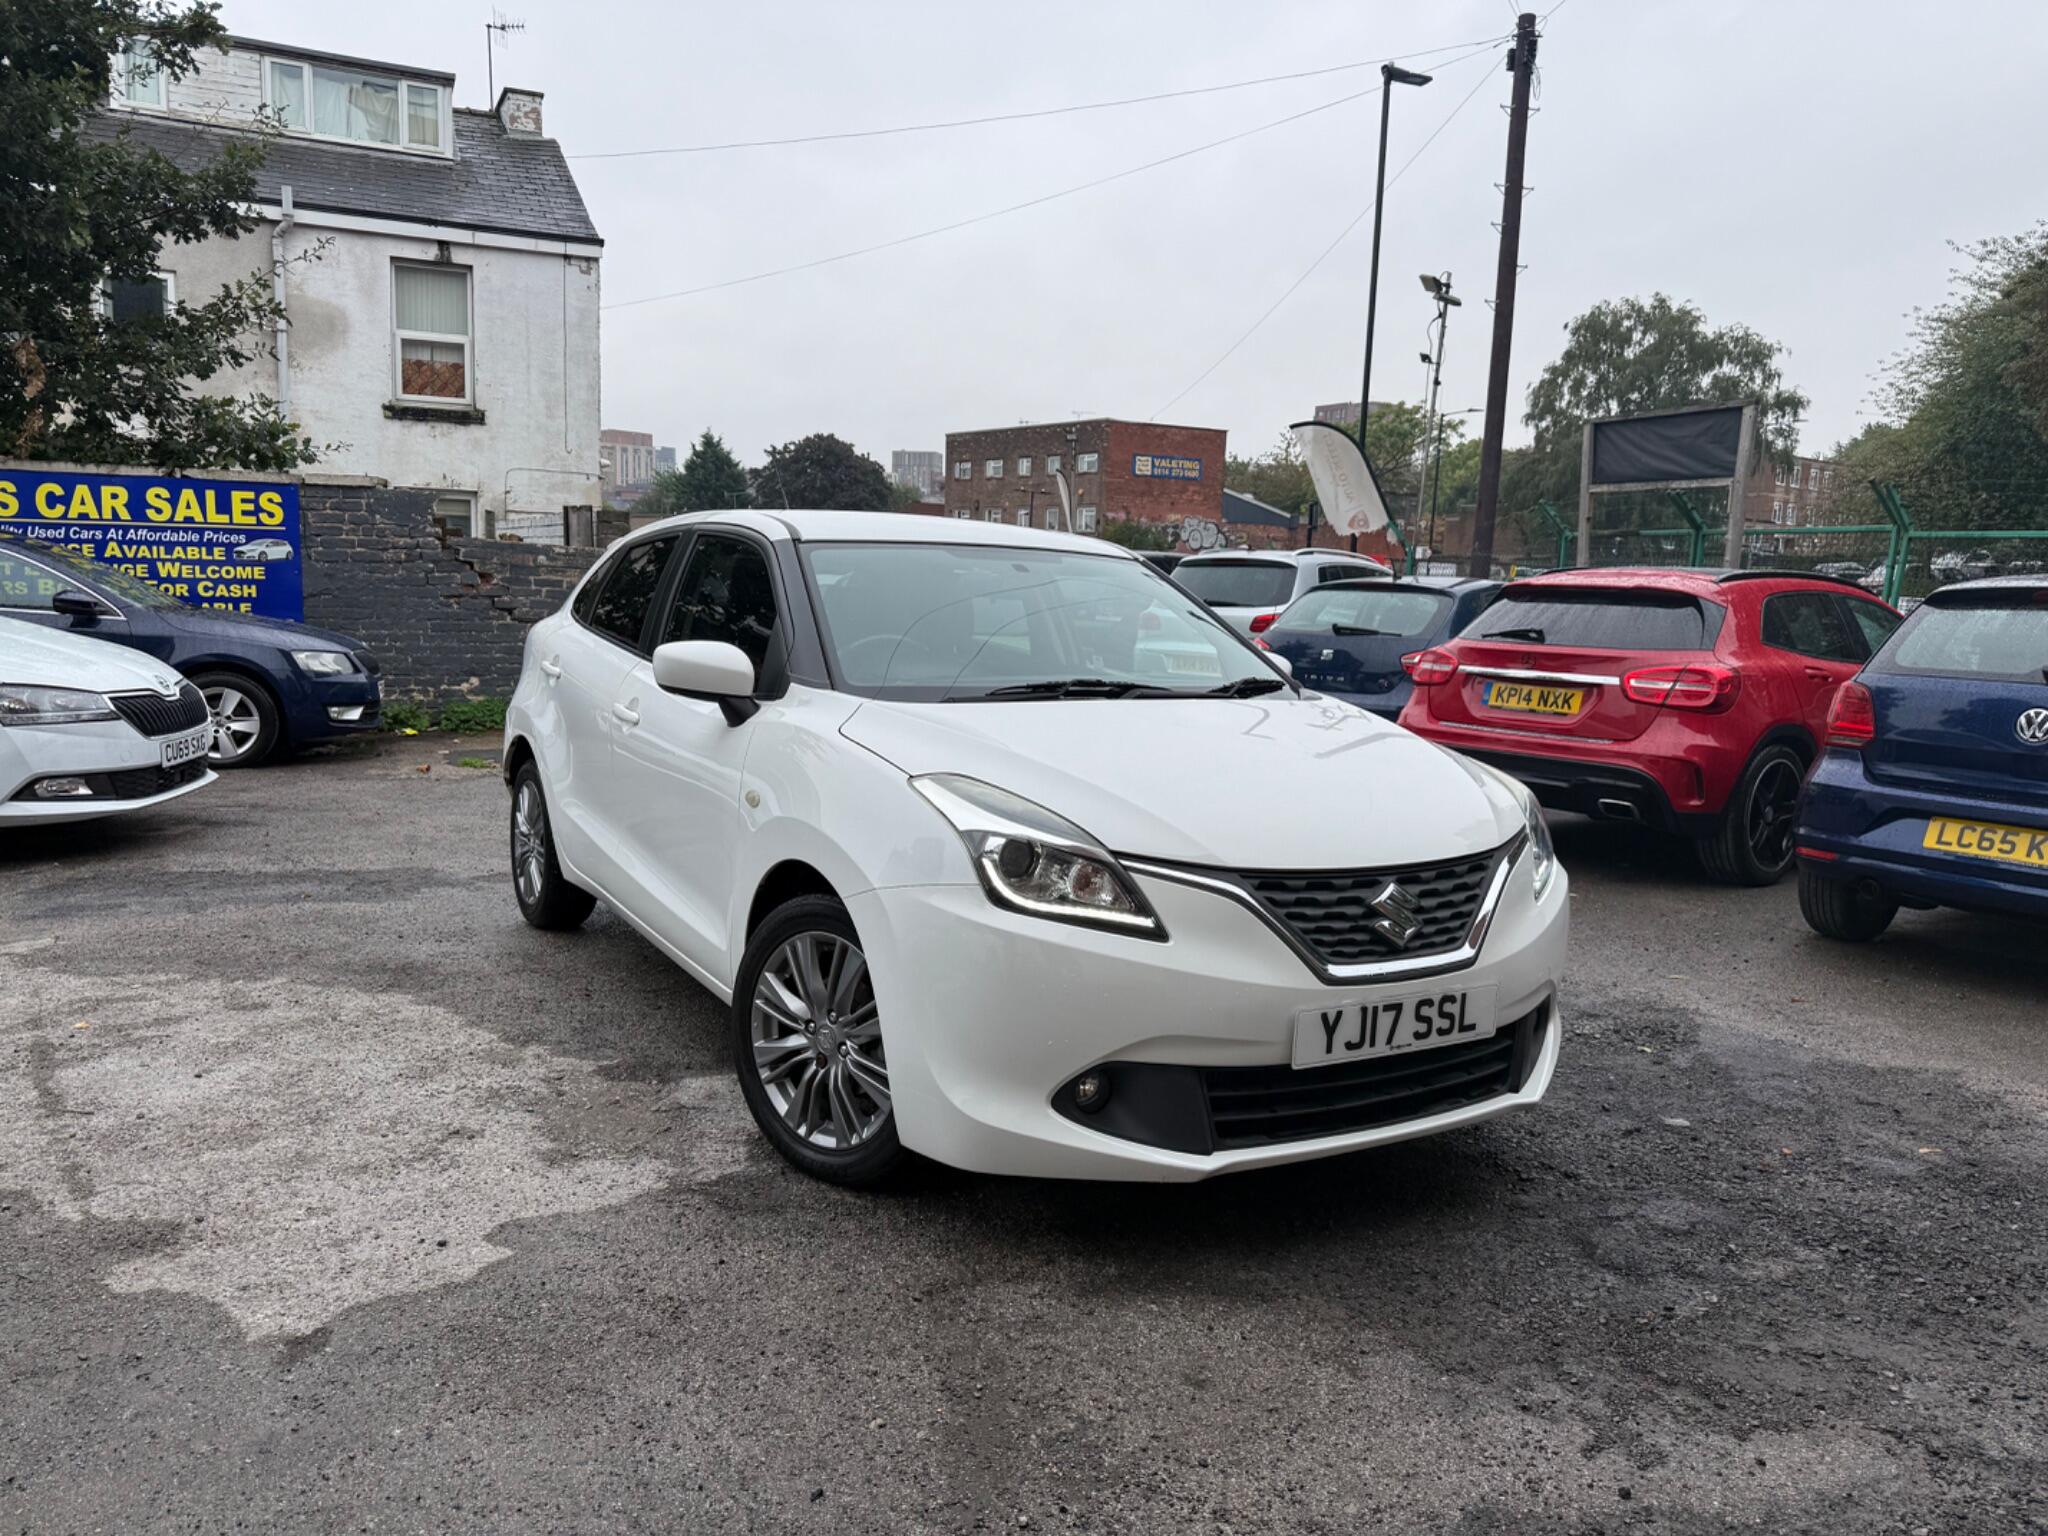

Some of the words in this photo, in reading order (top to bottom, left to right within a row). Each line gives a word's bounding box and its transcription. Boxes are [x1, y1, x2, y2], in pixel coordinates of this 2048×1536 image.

[35, 482, 131, 520] CAR
[145, 487, 284, 525] SALES
[27, 525, 65, 539] Used
[70, 527, 102, 540] Cars
[106, 528, 122, 540] At
[125, 529, 200, 543] Affordable
[203, 531, 246, 544] Prices
[104, 541, 226, 561] AVAILABLE
[156, 561, 266, 580] WELCOME
[197, 581, 257, 598] CASH
[1495, 686, 1533, 706] KP14
[1537, 690, 1575, 710] NXK
[165, 738, 190, 762] CU69
[1935, 822, 2020, 855] LC65
[1320, 1002, 1404, 1054] YJ17
[1412, 993, 1477, 1042] SSL
